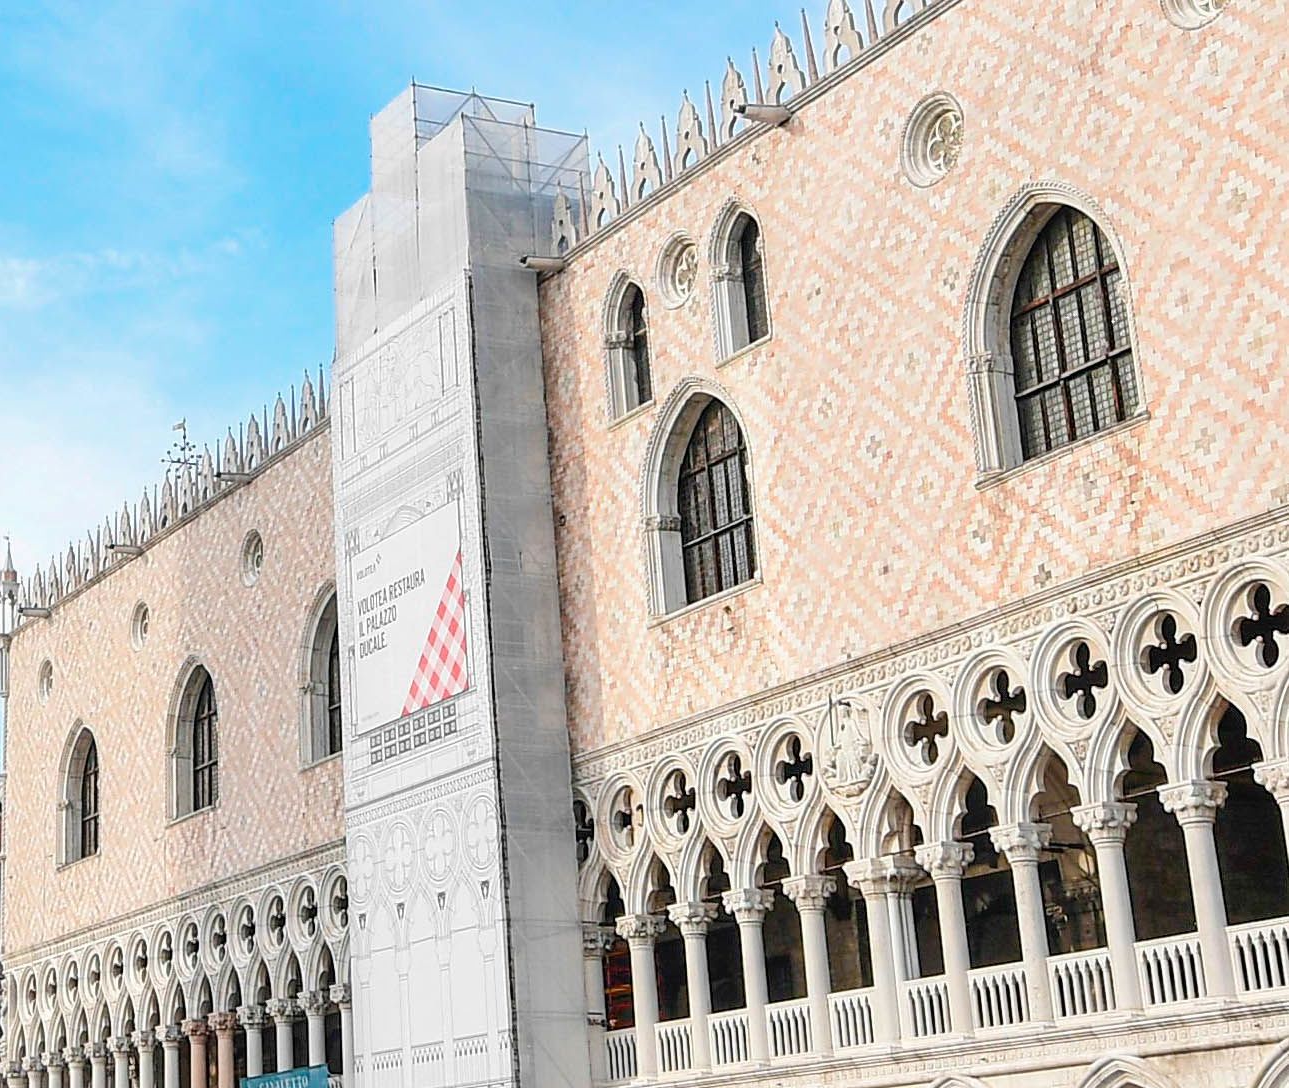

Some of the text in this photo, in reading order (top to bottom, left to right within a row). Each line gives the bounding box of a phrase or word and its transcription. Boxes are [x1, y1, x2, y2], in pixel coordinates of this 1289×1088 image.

[357, 568, 426, 616] VOLOTEA RESTAURA
[366, 604, 397, 635] PALAZZO
